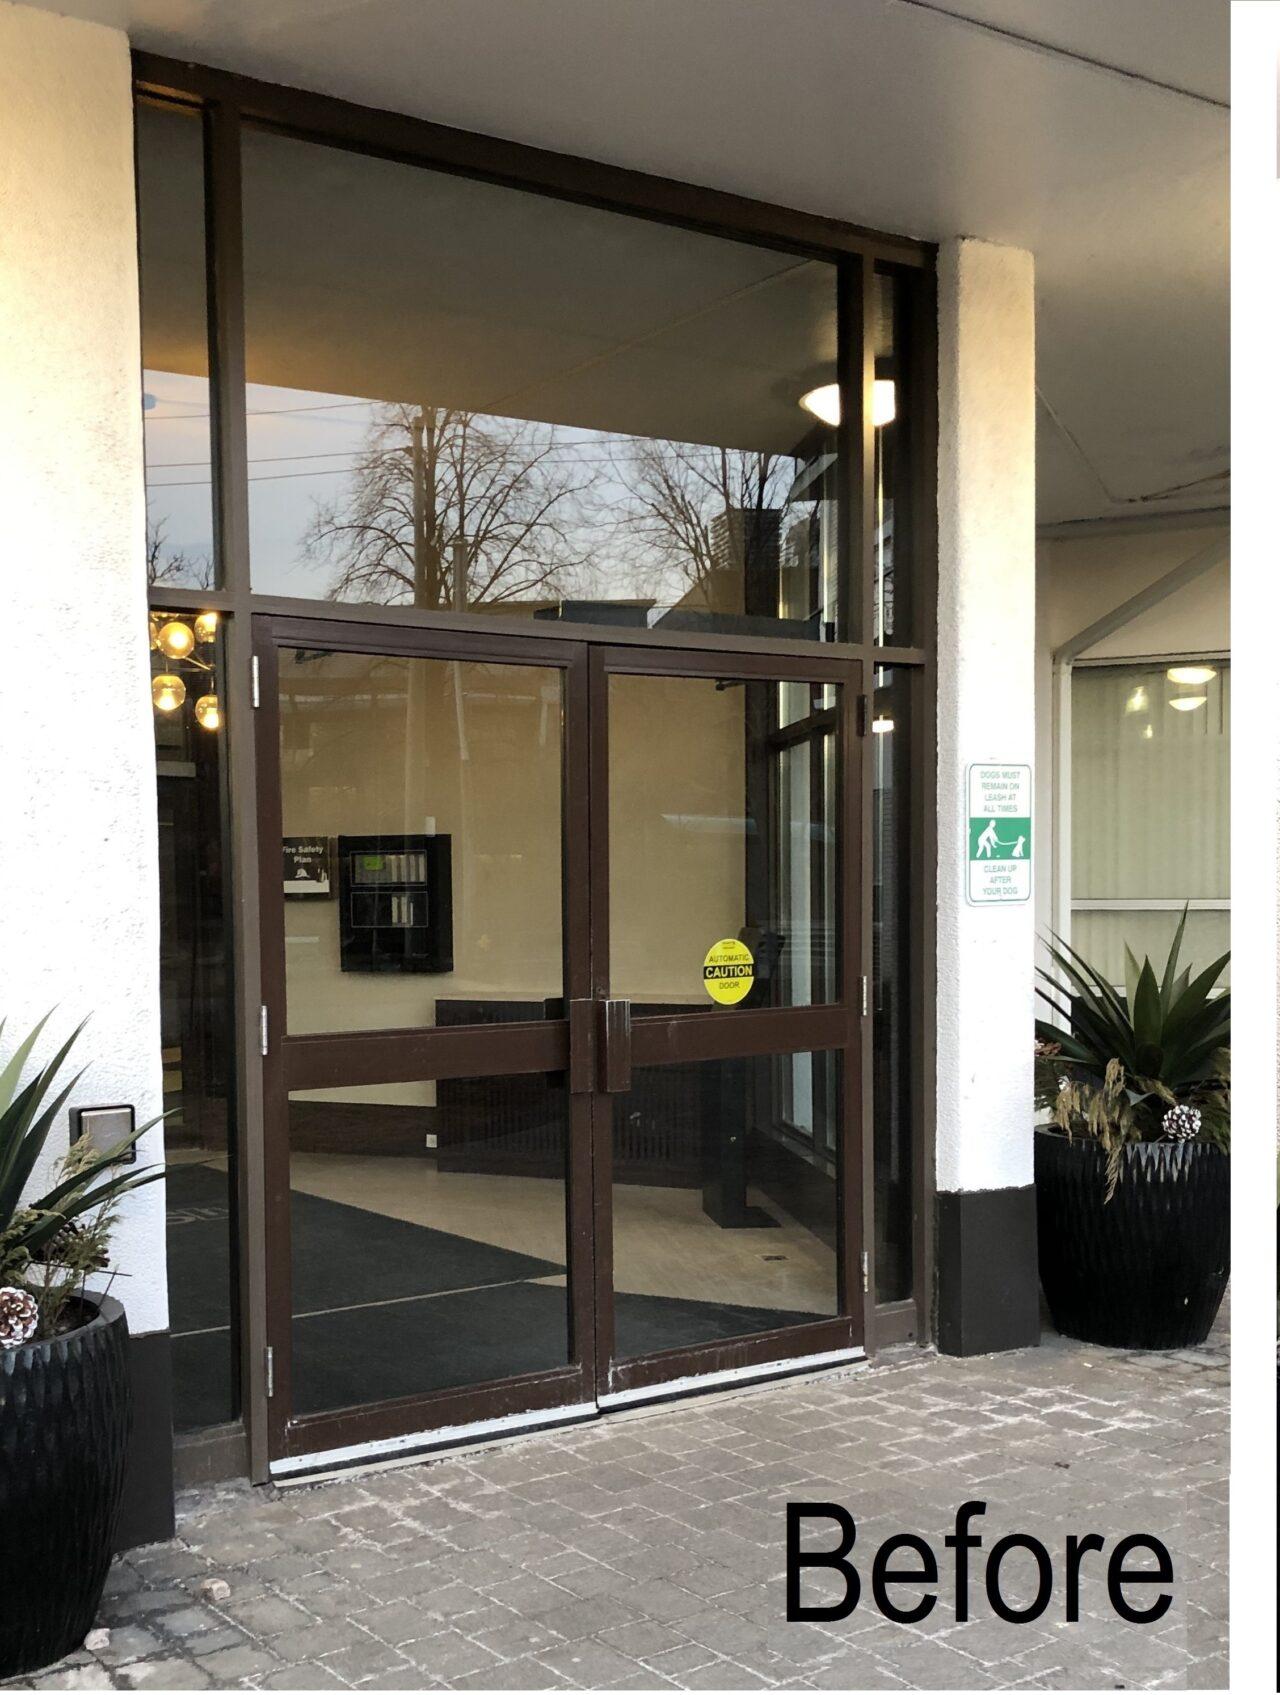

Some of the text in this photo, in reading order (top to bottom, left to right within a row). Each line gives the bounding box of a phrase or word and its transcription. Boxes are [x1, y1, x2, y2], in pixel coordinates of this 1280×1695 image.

[980, 771, 1020, 779] DOGS MUST
[981, 782, 1020, 790] REMAIN ON
[984, 793, 1017, 802] LEASH AT
[983, 804, 1018, 813] ALL TIMES
[298, 846, 323, 854] Safety
[989, 875, 1012, 884] AFTER
[983, 886, 1018, 895] YOUR DOG
[709, 954, 749, 962] AUTOMATIC
[705, 966, 752, 977] CAUTION
